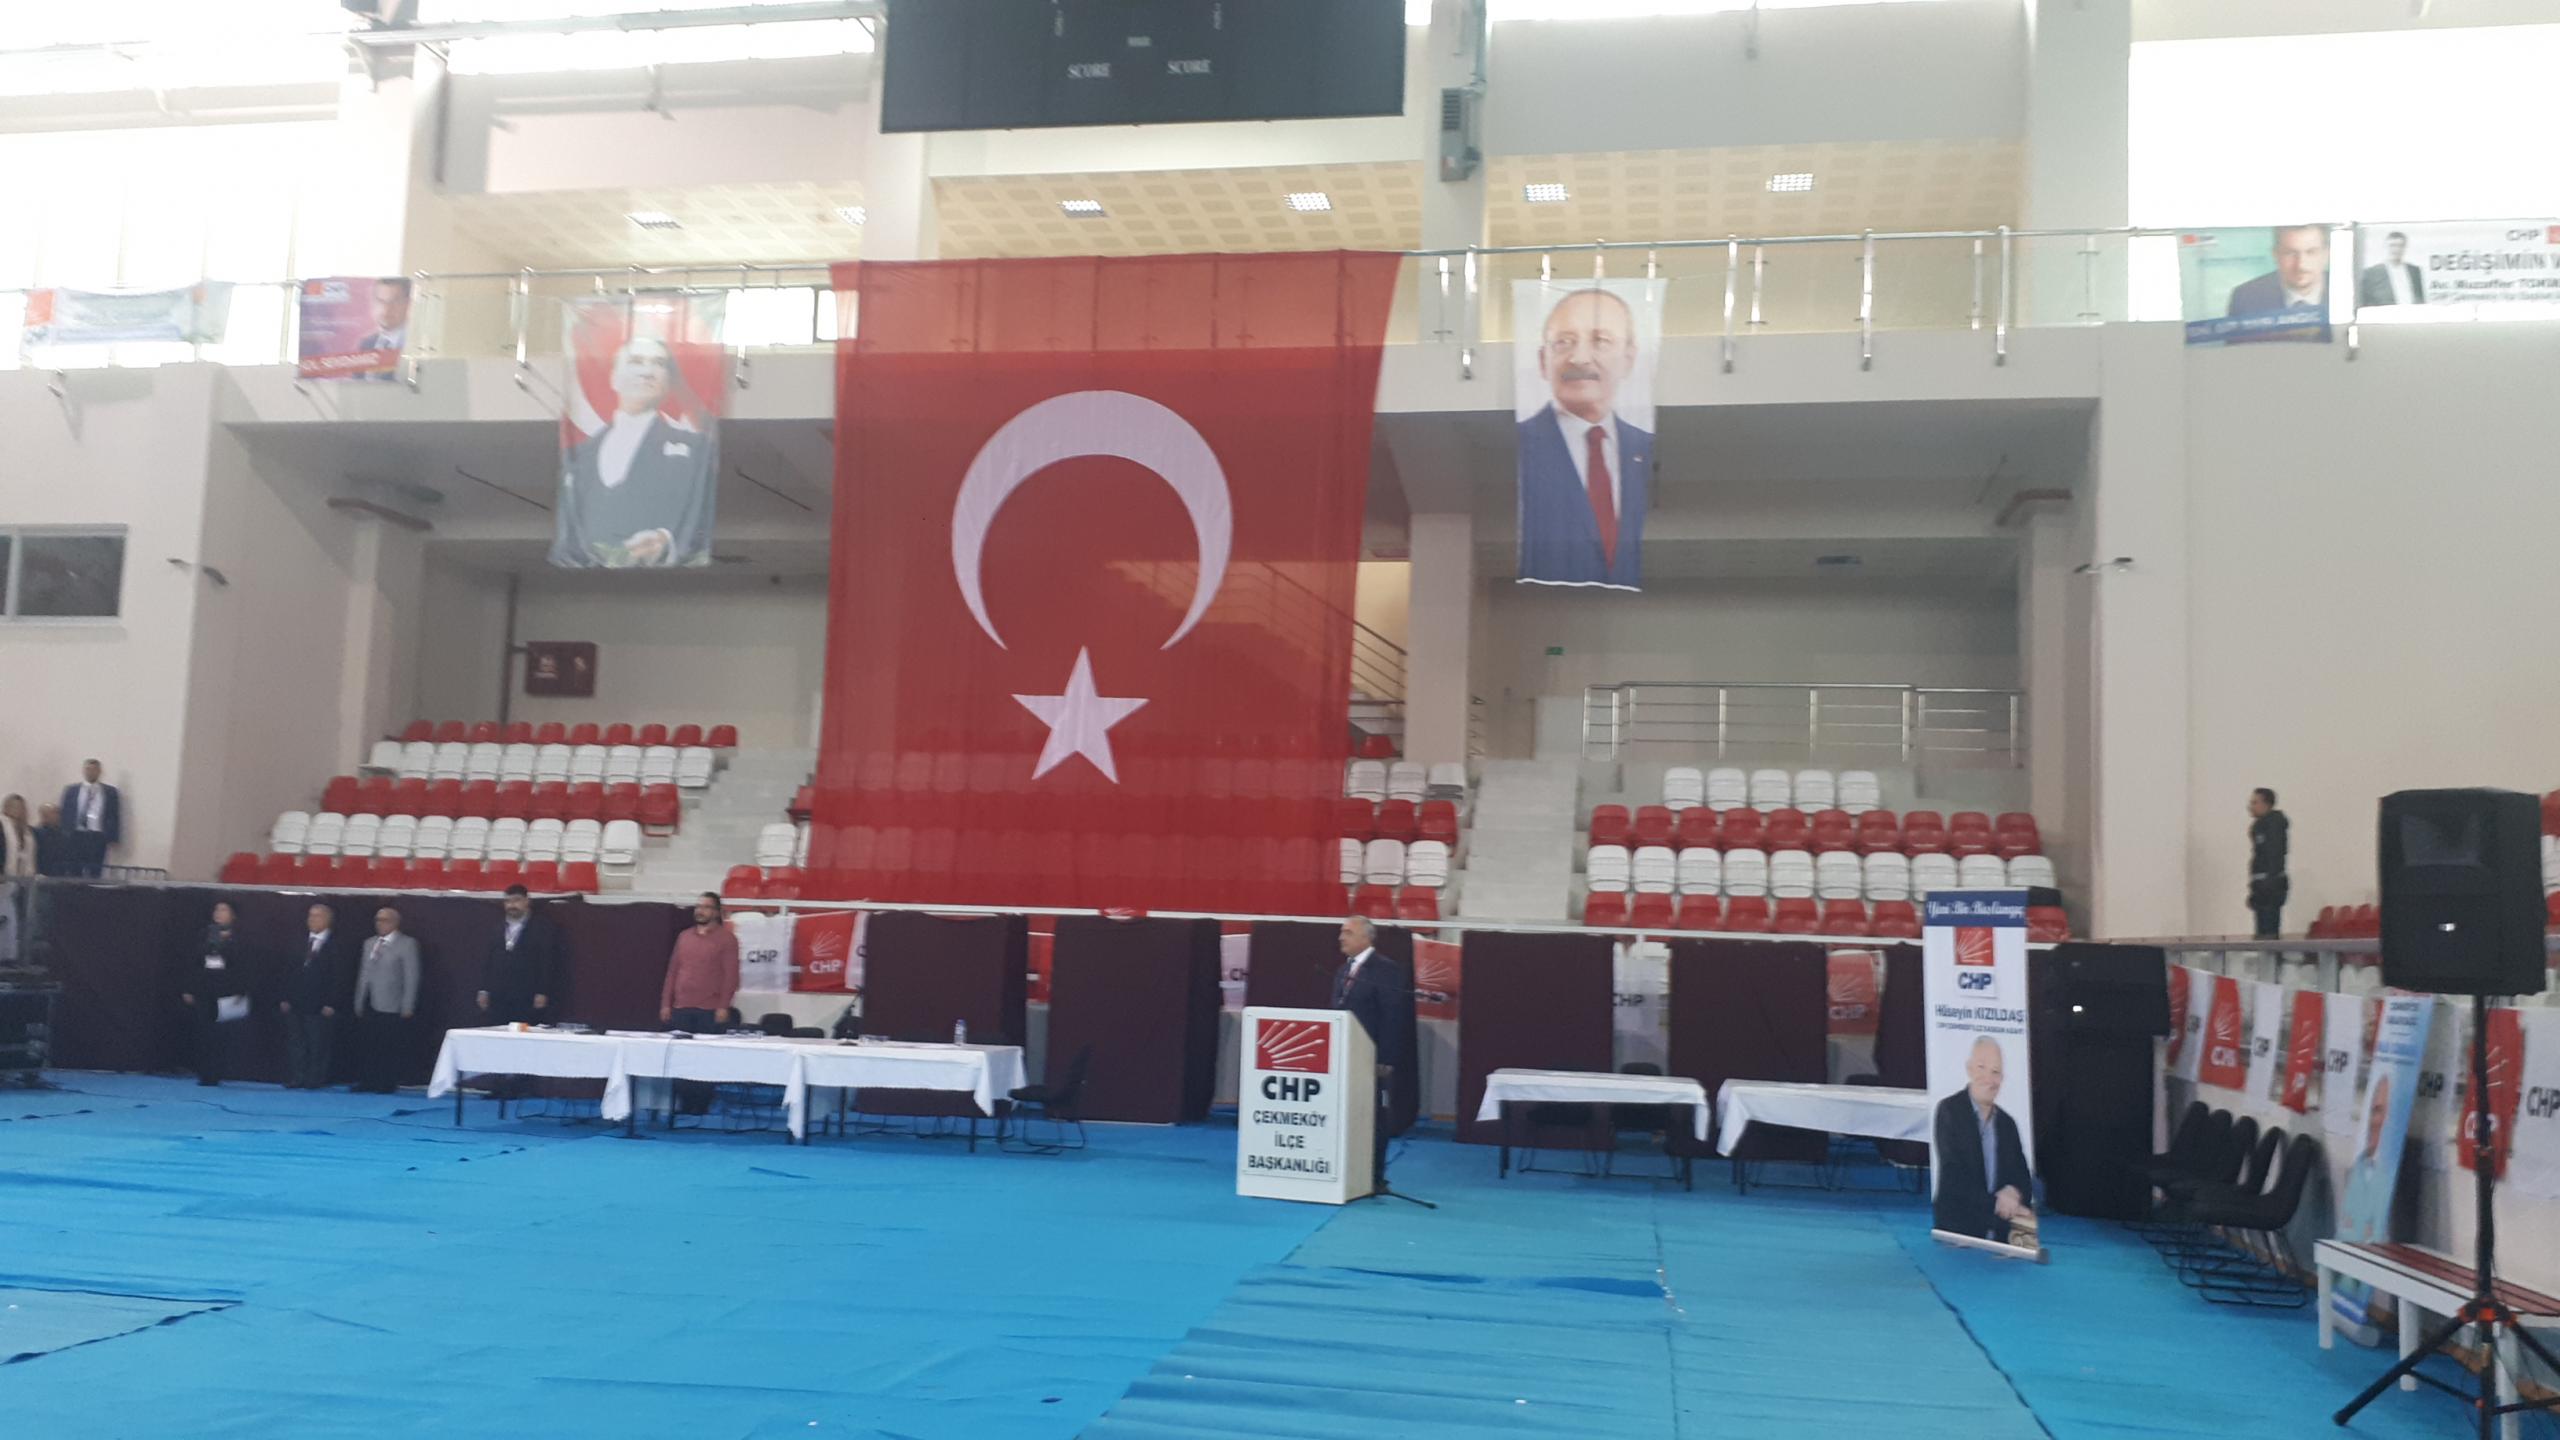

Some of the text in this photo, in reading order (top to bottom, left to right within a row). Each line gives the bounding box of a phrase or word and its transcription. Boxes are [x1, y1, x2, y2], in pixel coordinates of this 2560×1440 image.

[1067, 63, 1111, 78] SCORE
[1167, 59, 1211, 74] SCORE
[747, 949, 778, 963] CHP
[809, 959, 841, 974] CHP
[1958, 972, 1992, 990] CHP
[1829, 1004, 1867, 1019] CHP
[1935, 1005, 1973, 1020] Hüseyin
[2327, 1048, 2349, 1074] CHP
[1261, 1075, 1321, 1102] CHP
[2526, 1086, 2560, 1118] CHP
[1253, 1109, 1327, 1128] ÇEKMEKÖY
[1274, 1131, 1305, 1150] İLÇE
[1248, 1154, 1330, 1174] BAŞKANLIĞI
